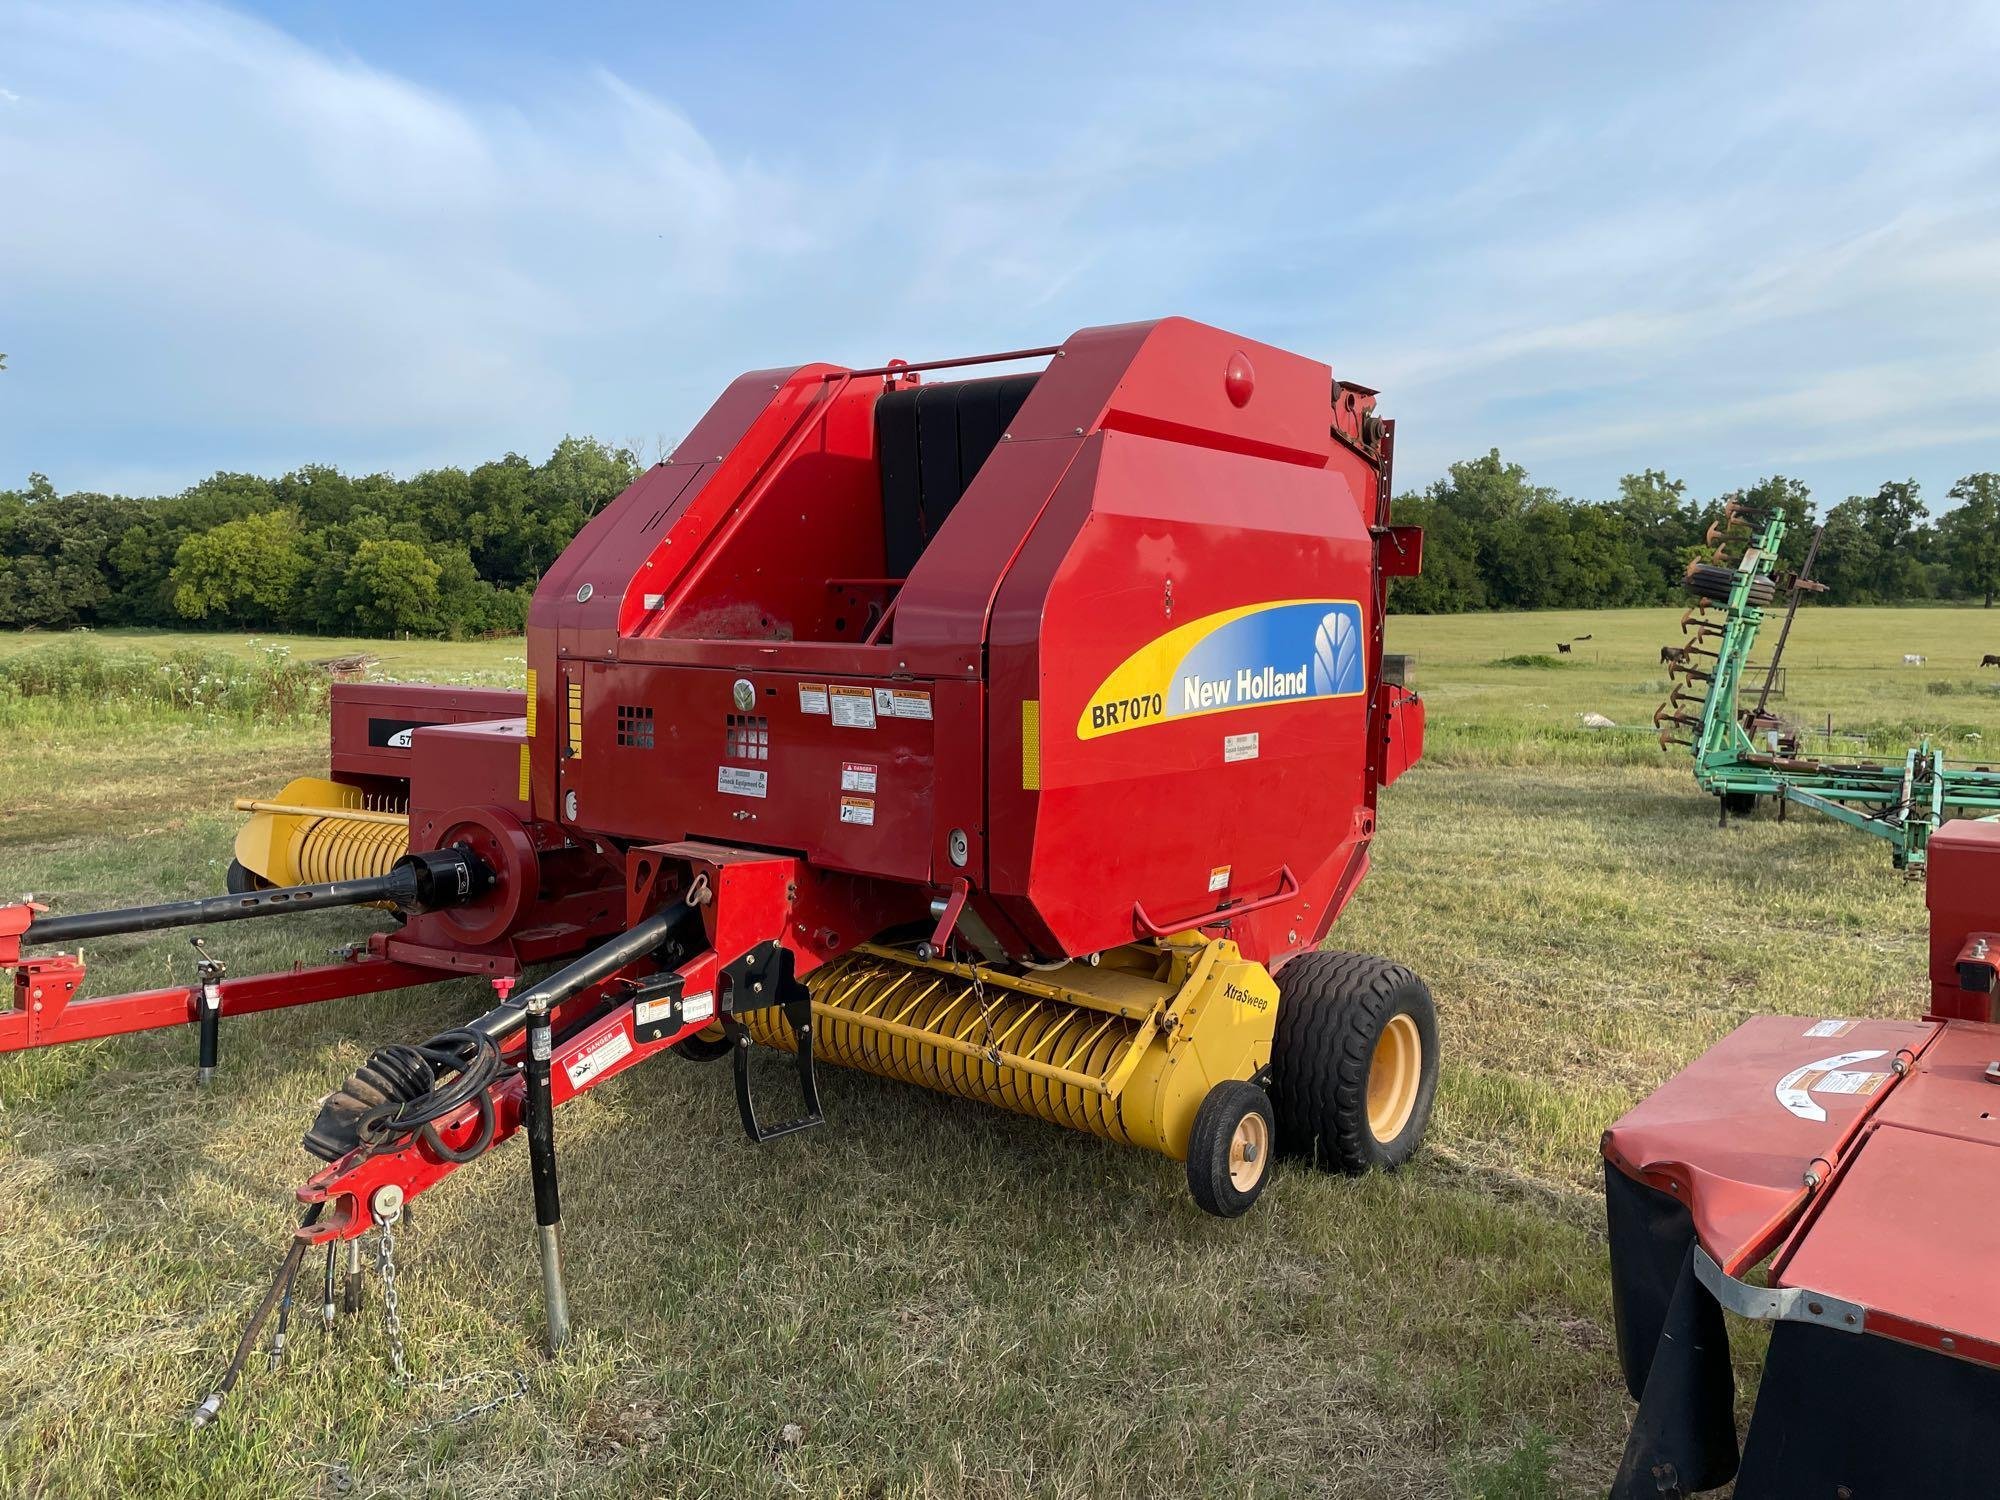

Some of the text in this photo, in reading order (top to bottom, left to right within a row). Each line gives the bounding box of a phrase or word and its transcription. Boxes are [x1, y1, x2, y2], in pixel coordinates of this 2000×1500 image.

[842, 688, 865, 696] WARNING
[1184, 664, 1307, 710] New Holland
[1092, 693, 1162, 729] BR7070
[1224, 983, 1268, 1012] XtraSweep
[586, 1033, 613, 1053] DANGER
